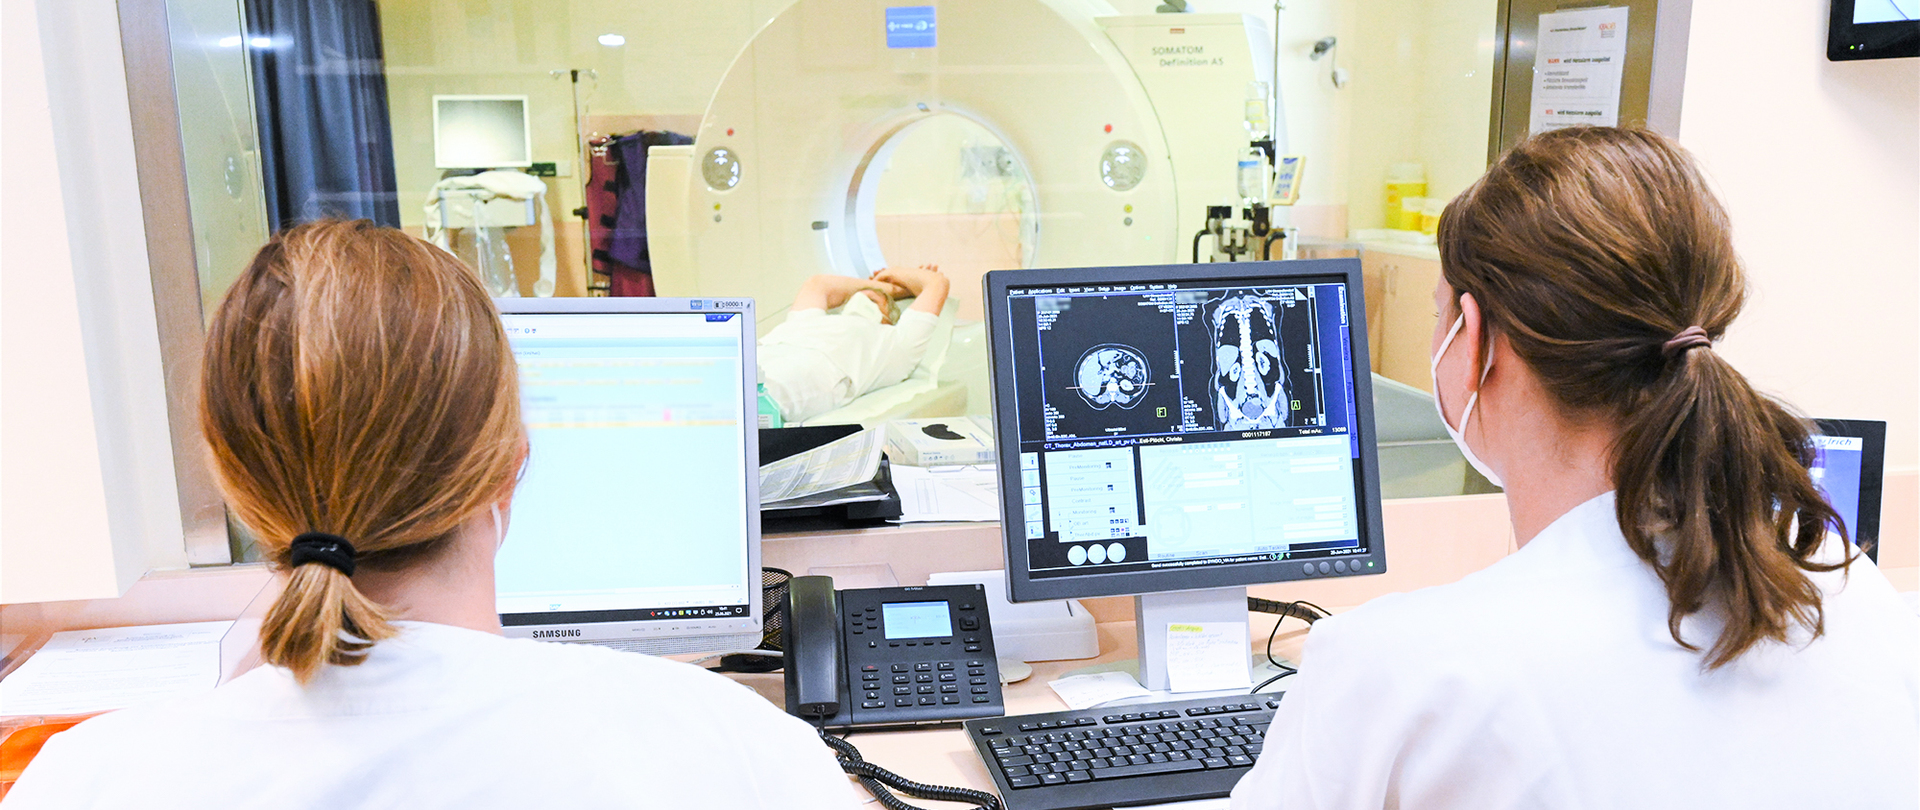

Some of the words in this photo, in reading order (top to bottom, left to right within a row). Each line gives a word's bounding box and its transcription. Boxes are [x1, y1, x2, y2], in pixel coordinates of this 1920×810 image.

[1152, 46, 1204, 56] SOMATOM
[1160, 58, 1208, 67] Definition
[532, 629, 581, 639] SAMSUNG
